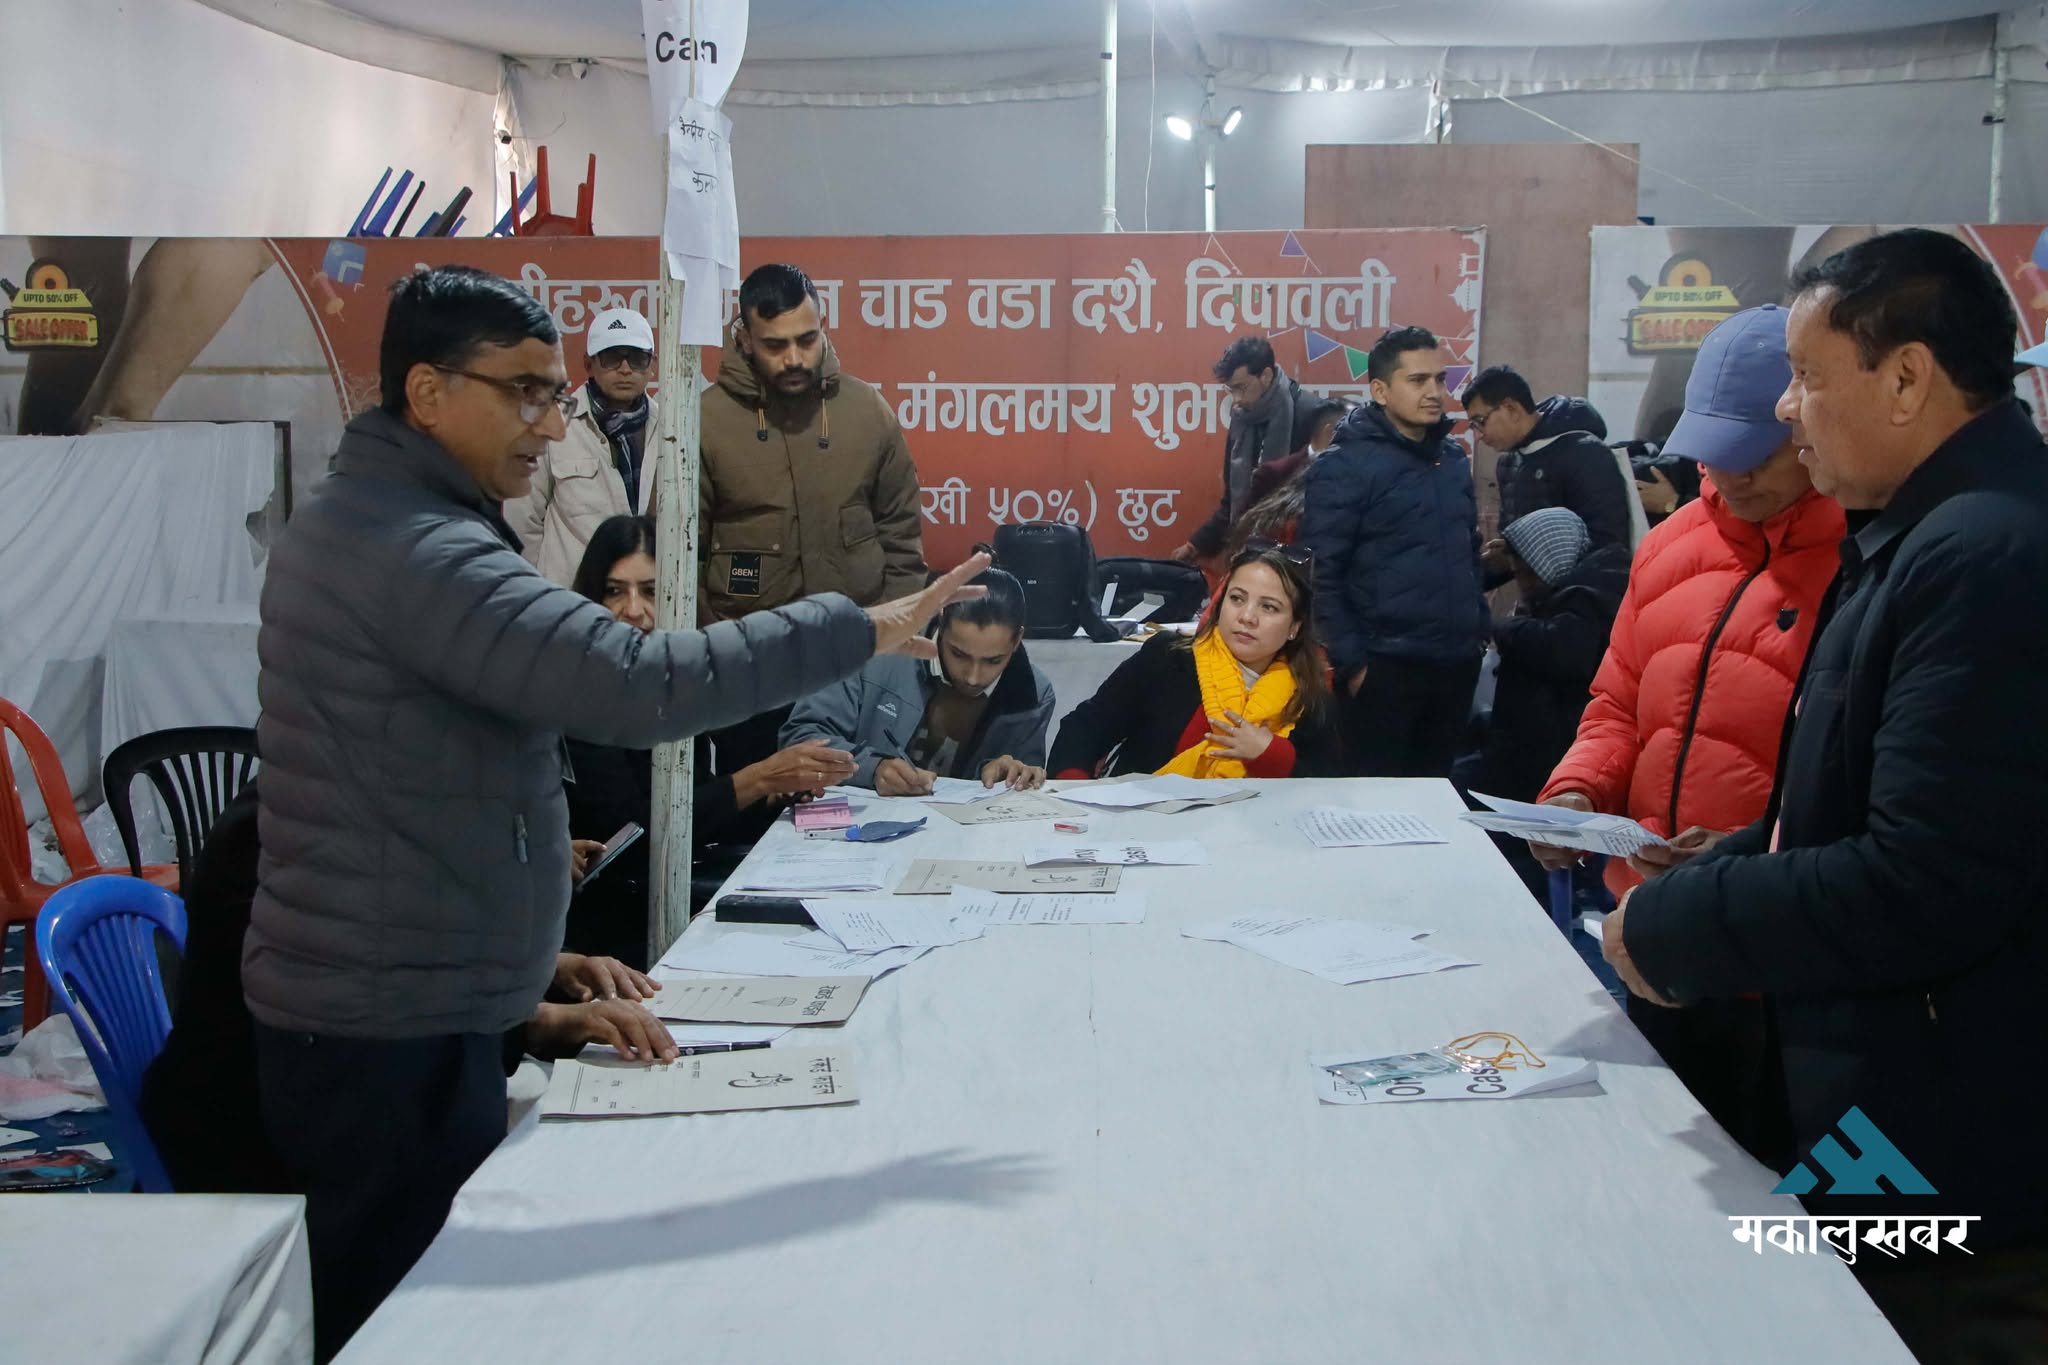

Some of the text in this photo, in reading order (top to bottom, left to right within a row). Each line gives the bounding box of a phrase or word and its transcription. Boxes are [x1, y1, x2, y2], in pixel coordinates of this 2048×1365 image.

[23, 293, 79, 303] UPTO 50% OFF
[859, 278, 952, 330] चाड
[968, 278, 1056, 330] वडा
[1185, 258, 1397, 333] दिपावली
[1654, 290, 1681, 302] UPTO
[1704, 289, 1723, 301] OFF
[15, 317, 89, 341] SALE OFFER
[897, 370, 1116, 436] मंगलमय
[1115, 488, 1182, 542] छुट
[731, 567, 753, 577] GBEN
[1466, 1066, 1507, 1095] Cas
